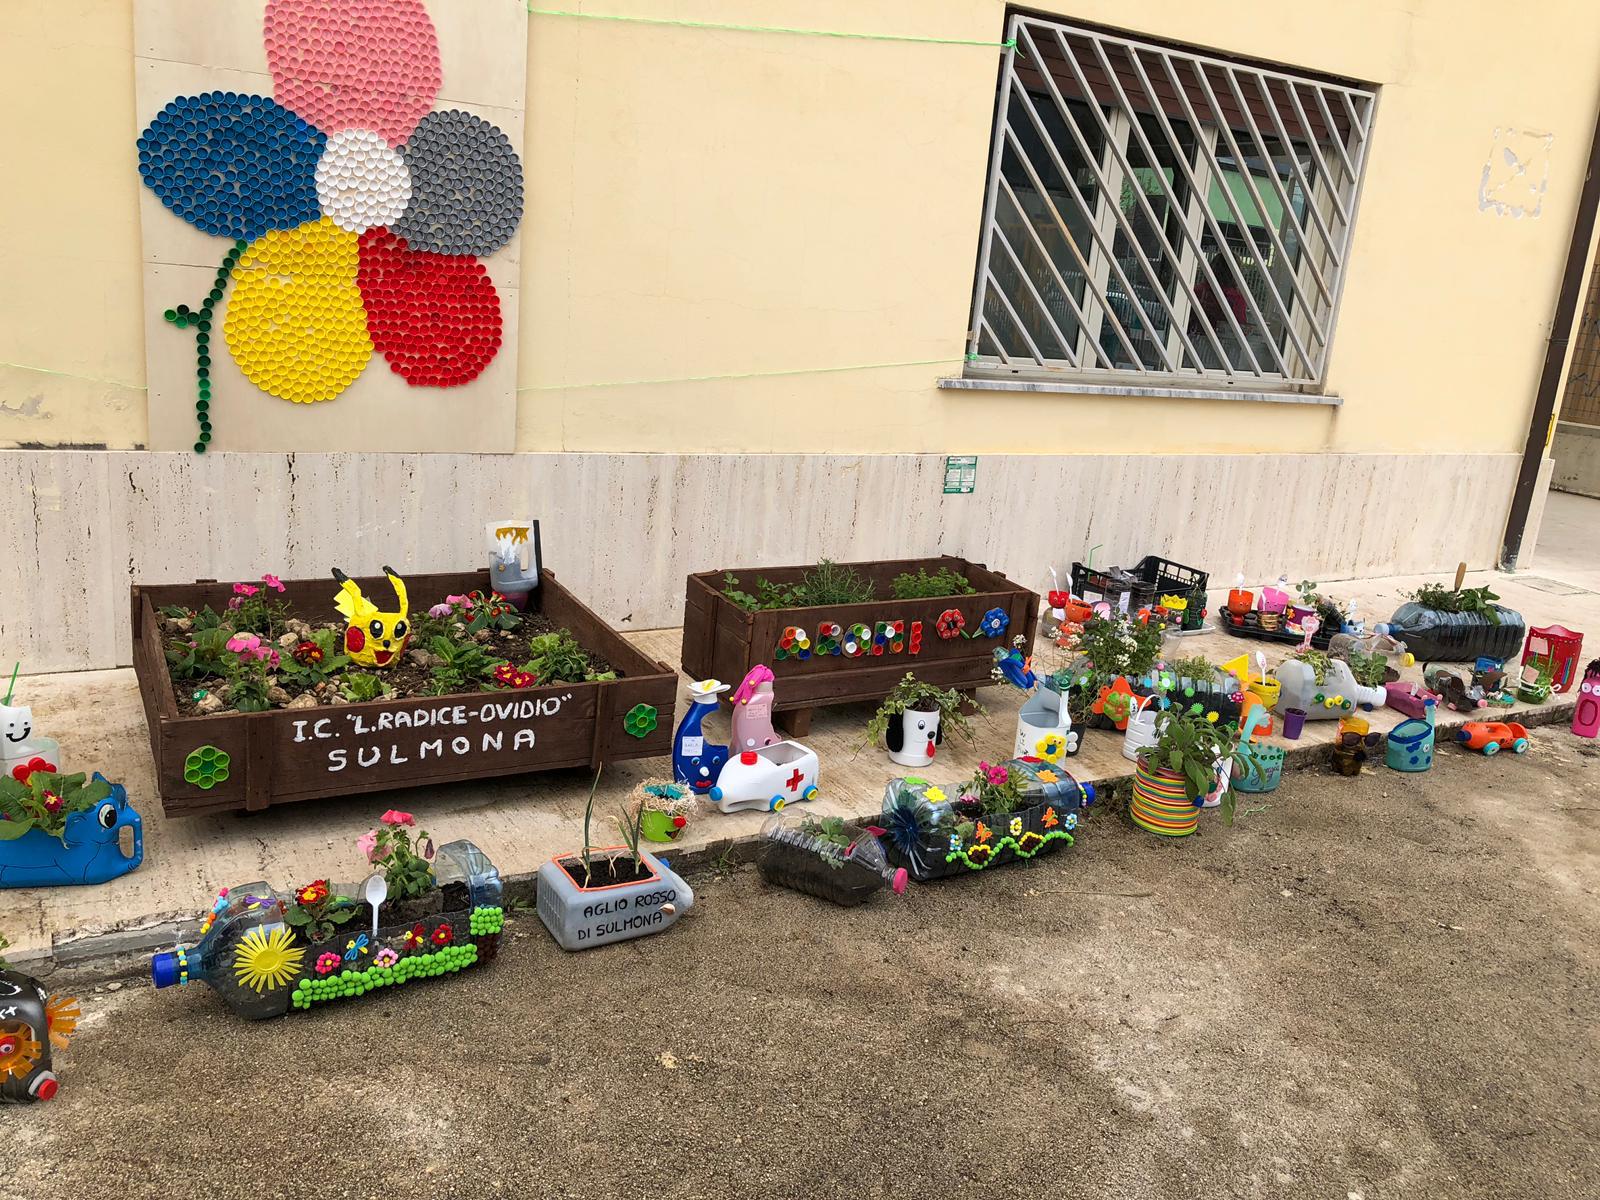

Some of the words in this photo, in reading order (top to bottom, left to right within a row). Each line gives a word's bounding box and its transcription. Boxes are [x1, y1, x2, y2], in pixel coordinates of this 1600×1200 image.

[292, 718, 340, 742] I.C.
[328, 728, 536, 772] SULMONA
[583, 898, 628, 919] AGLIO
[635, 889, 677, 908] ROSSO
[577, 927, 591, 941] DI
[596, 911, 663, 937] SULMONA
